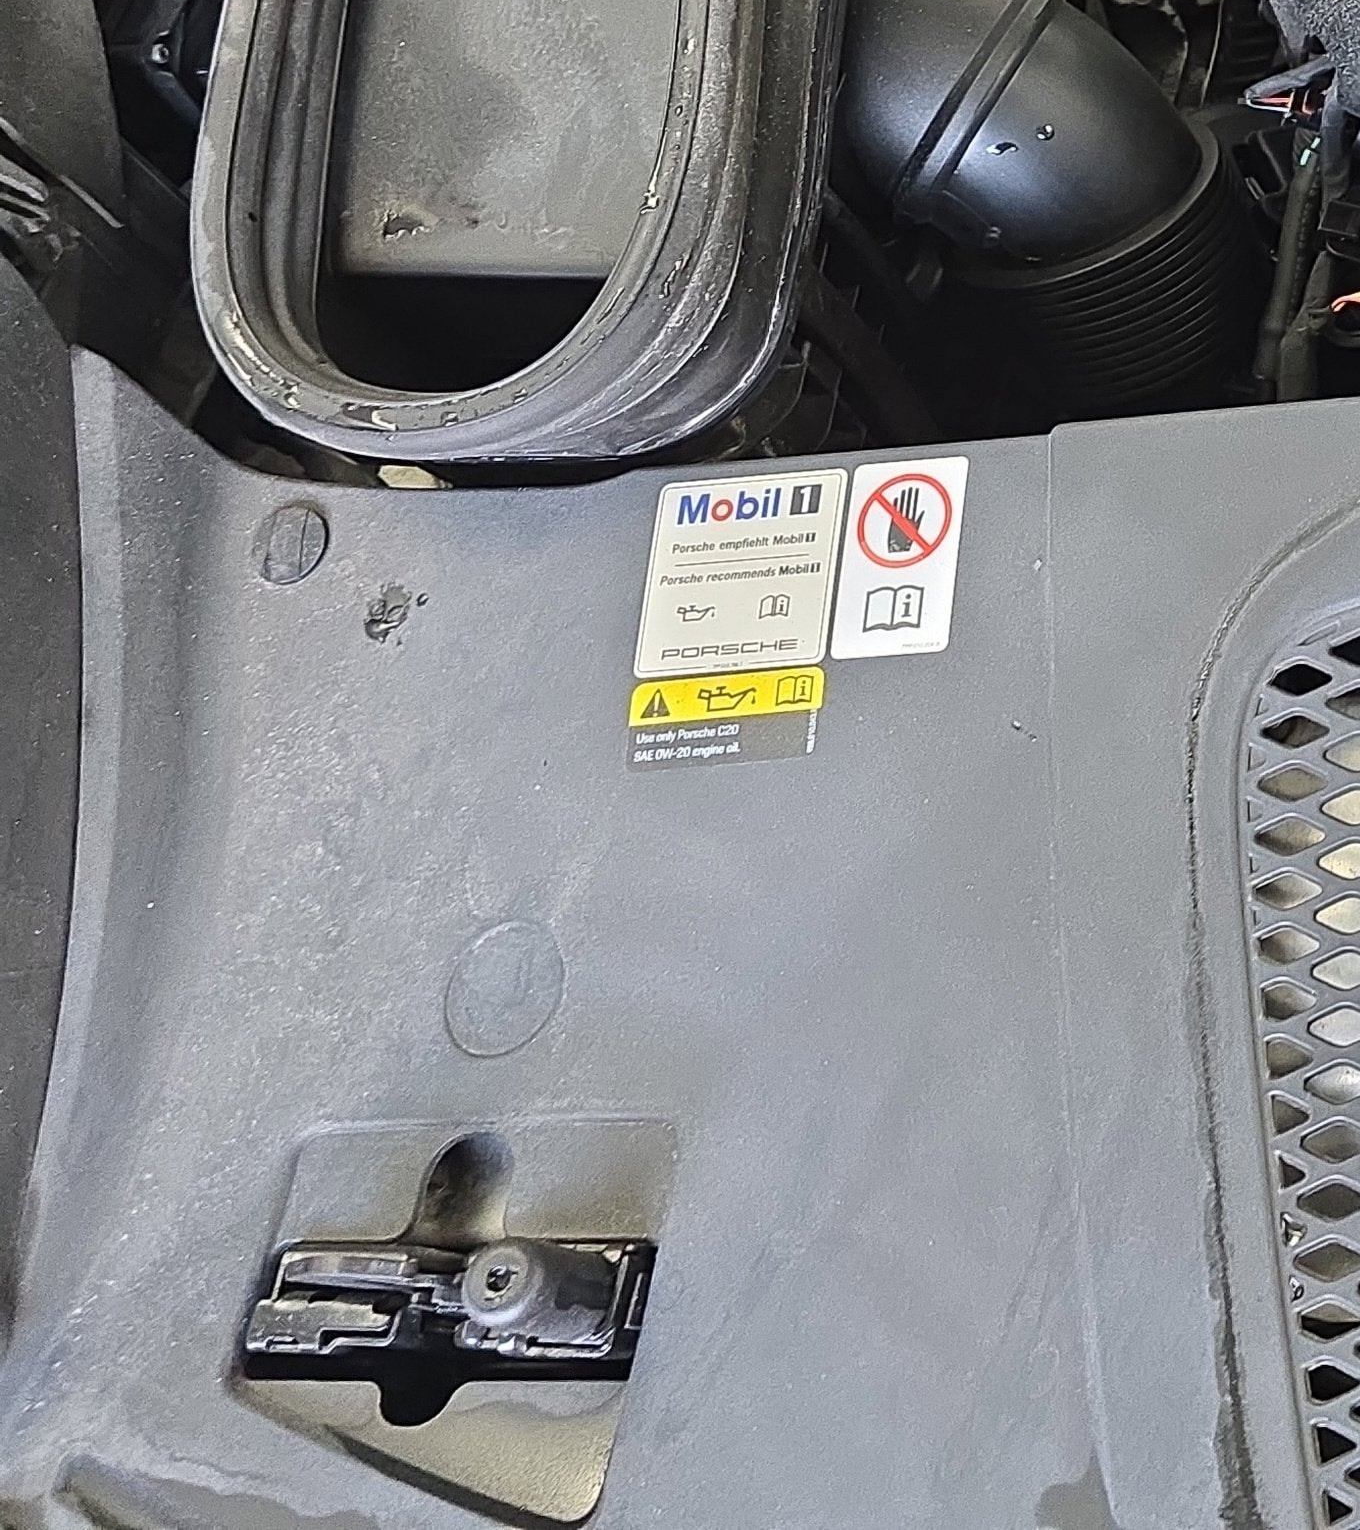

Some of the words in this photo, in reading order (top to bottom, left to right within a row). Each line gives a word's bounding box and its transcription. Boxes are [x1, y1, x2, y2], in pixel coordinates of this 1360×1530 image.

[676, 487, 782, 526] Mobil
[672, 542, 715, 554] Porsche
[719, 537, 770, 550] empfiehlt
[773, 533, 804, 546] Mobil
[659, 573, 703, 586] Porsche
[706, 567, 776, 582] recommends
[779, 564, 809, 576] Mobil
[661, 638, 799, 660] PORSCHE
[635, 732, 654, 744] Use
[656, 730, 677, 743] only
[677, 727, 716, 740] Porsche
[717, 724, 740, 737] C20
[633, 749, 654, 762] SAE
[655, 746, 691, 761] 0W-20
[692, 744, 725, 758] engine
[726, 741, 741, 754] oil.
